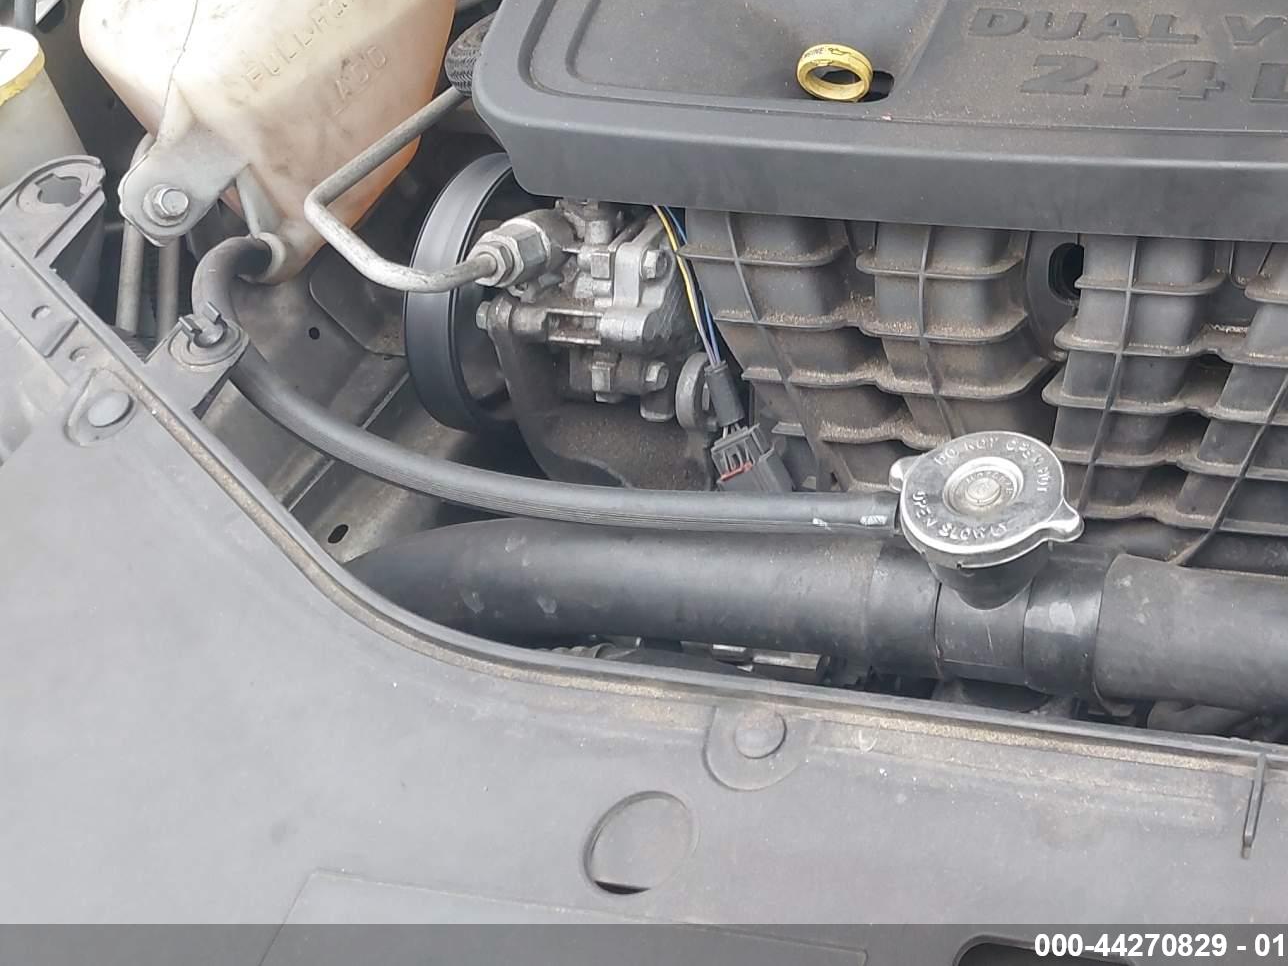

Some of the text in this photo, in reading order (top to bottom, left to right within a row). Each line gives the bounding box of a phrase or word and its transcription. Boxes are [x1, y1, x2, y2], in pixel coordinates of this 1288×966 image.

[968, 7, 1200, 44] DUAL
[934, 447, 960, 466] DO
[963, 436, 999, 452] NOT
[1005, 439, 1044, 467] OPEN
[912, 490, 1009, 541] OPEN SLOWLY
